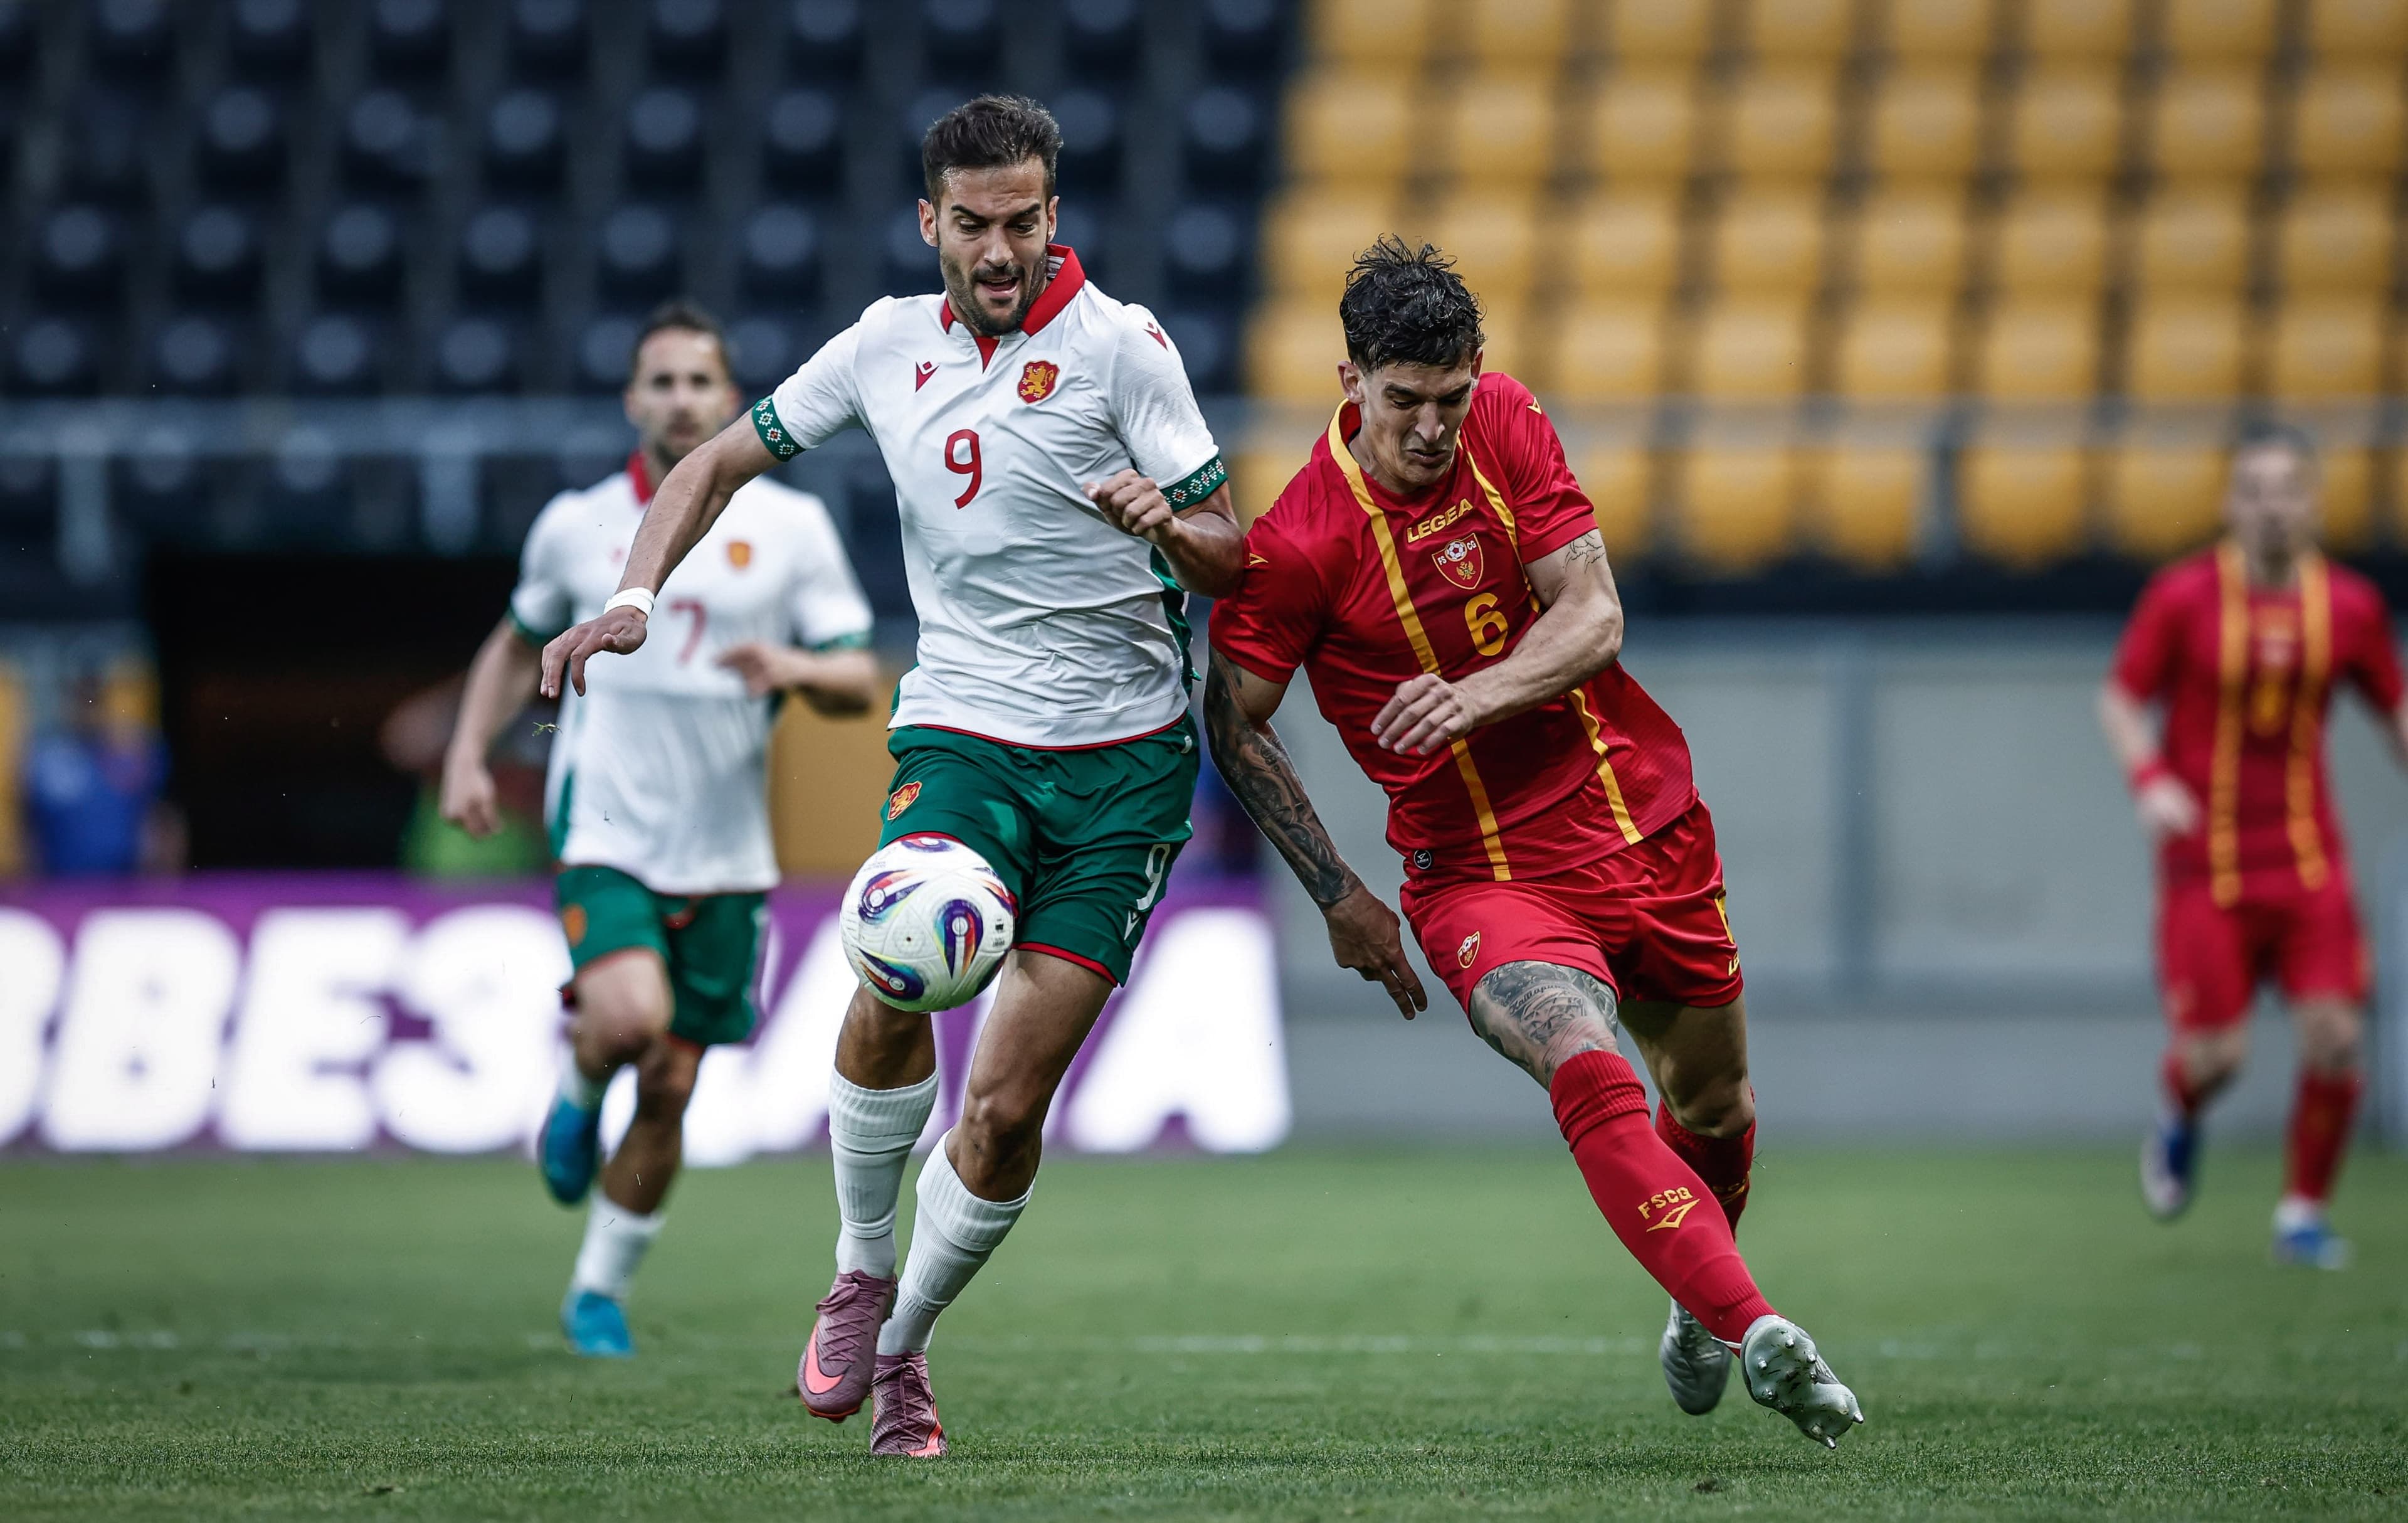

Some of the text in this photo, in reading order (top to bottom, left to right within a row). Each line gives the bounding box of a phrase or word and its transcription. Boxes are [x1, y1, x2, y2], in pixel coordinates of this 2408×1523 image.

[944, 428, 983, 510] 9
[1407, 497, 1474, 544] LEGEA
[1437, 539, 1477, 566] FS CG
[667, 598, 707, 669] 7
[1464, 592, 1508, 656] 6
[1136, 843, 1171, 911] 9
